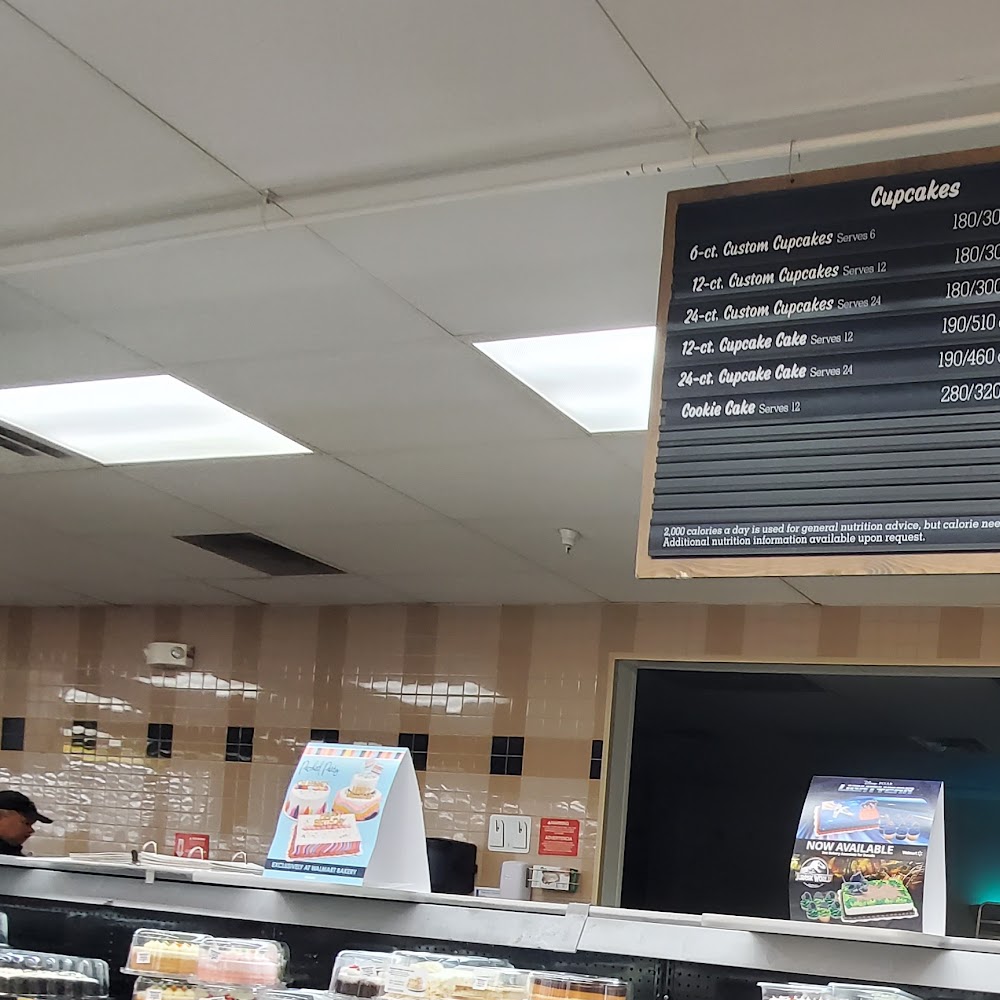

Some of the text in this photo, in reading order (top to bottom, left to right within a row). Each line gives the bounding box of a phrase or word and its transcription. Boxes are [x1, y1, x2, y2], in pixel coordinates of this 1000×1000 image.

[870, 179, 961, 210] Cupcakes
[690, 244, 718, 260] 6-ct.
[723, 239, 768, 257] Custom
[773, 231, 834, 253] Cupcakes
[836, 232, 868, 244] Serves
[870, 229, 876, 240] 6
[692, 276, 724, 292] 12-ct.
[728, 272, 774, 289] Custom
[778, 263, 840, 285] Cupcakes
[842, 264, 874, 276] Serves
[877, 262, 887, 272] 12
[684, 308, 718, 324] 24-ct.
[724, 304, 770, 322] Custom
[774, 297, 834, 318] Cupcakes
[837, 298, 868, 310] Serves
[870, 296, 882, 306] 24
[682, 340, 714, 356] 12-ct.
[719, 334, 772, 355] Cupcake
[776, 331, 807, 346] Cake
[810, 333, 842, 344] Serves
[844, 331, 854, 342] 12
[942, 313, 996, 333] 190/510
[678, 370, 714, 387] 24-ct.
[718, 366, 772, 387] Cupcake
[775, 364, 807, 379] Cake
[810, 366, 841, 378] Serves
[843, 364, 853, 375] 24
[938, 348, 994, 368] 190/460
[682, 401, 722, 418] Cookie
[725, 400, 755, 416] Cake
[758, 402, 789, 414] Serves
[792, 402, 800, 412] 12
[663, 532, 926, 547] Additional nutrition information available upon request.
[664, 527, 685, 536] 2,000
[686, 526, 722, 536] calories
[732, 525, 750, 536] day
[752, 525, 760, 534] is
[762, 524, 784, 533] used
[786, 524, 799, 533] for
[801, 522, 838, 534] general
[840, 521, 883, 532] nutrition
[885, 520, 922, 530] advice,
[924, 520, 941, 529] but
[943, 519, 978, 528] calorie
[806, 841, 894, 855] NOW AVAILABLE
